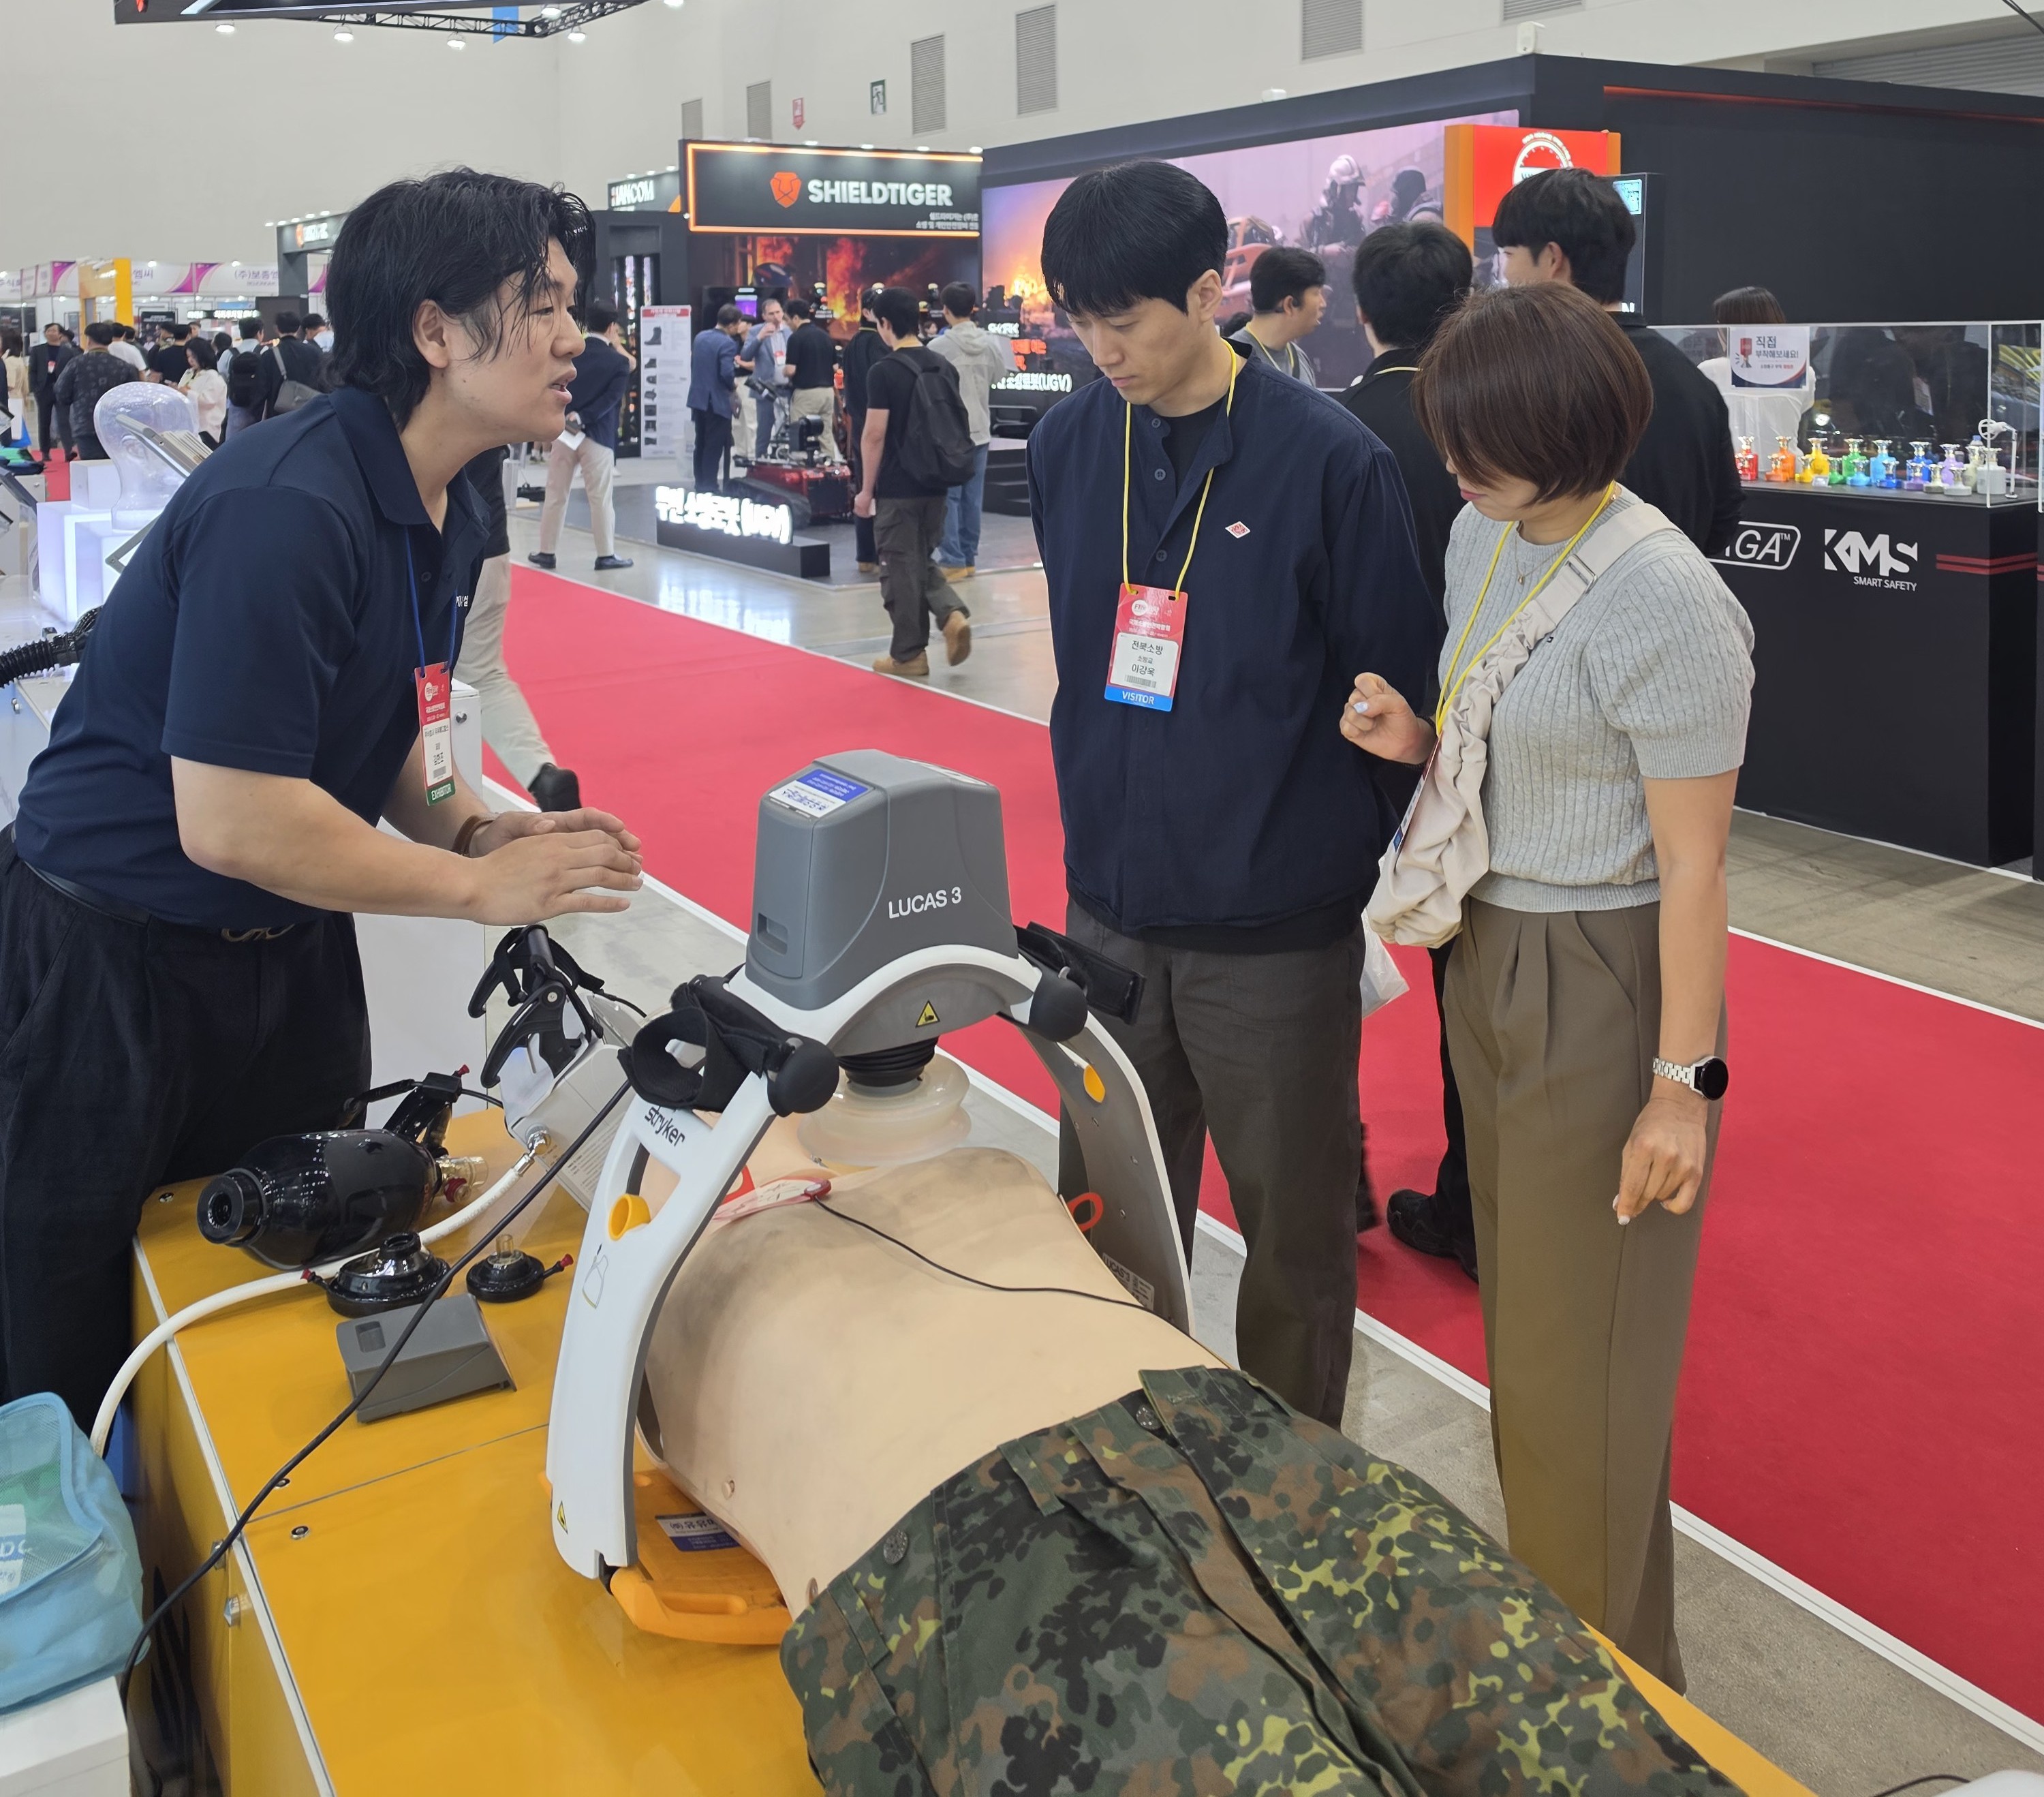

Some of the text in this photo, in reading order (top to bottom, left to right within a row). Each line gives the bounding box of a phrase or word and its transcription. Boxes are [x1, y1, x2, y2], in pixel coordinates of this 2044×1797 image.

[807, 179, 953, 206] SHIELDTIGER
[1755, 336, 1777, 348] 직접
[1755, 350, 1799, 358] 부착해보세요!
[1824, 528, 1918, 577] KMS
[1853, 576, 1918, 592] SMART SAFETY
[1132, 640, 1163, 656] 전북소방
[1131, 664, 1156, 677] 이강욱
[1122, 690, 1155, 705] VISITOR
[888, 886, 963, 919] LUCAS 3
[644, 1105, 685, 1147] stryker
